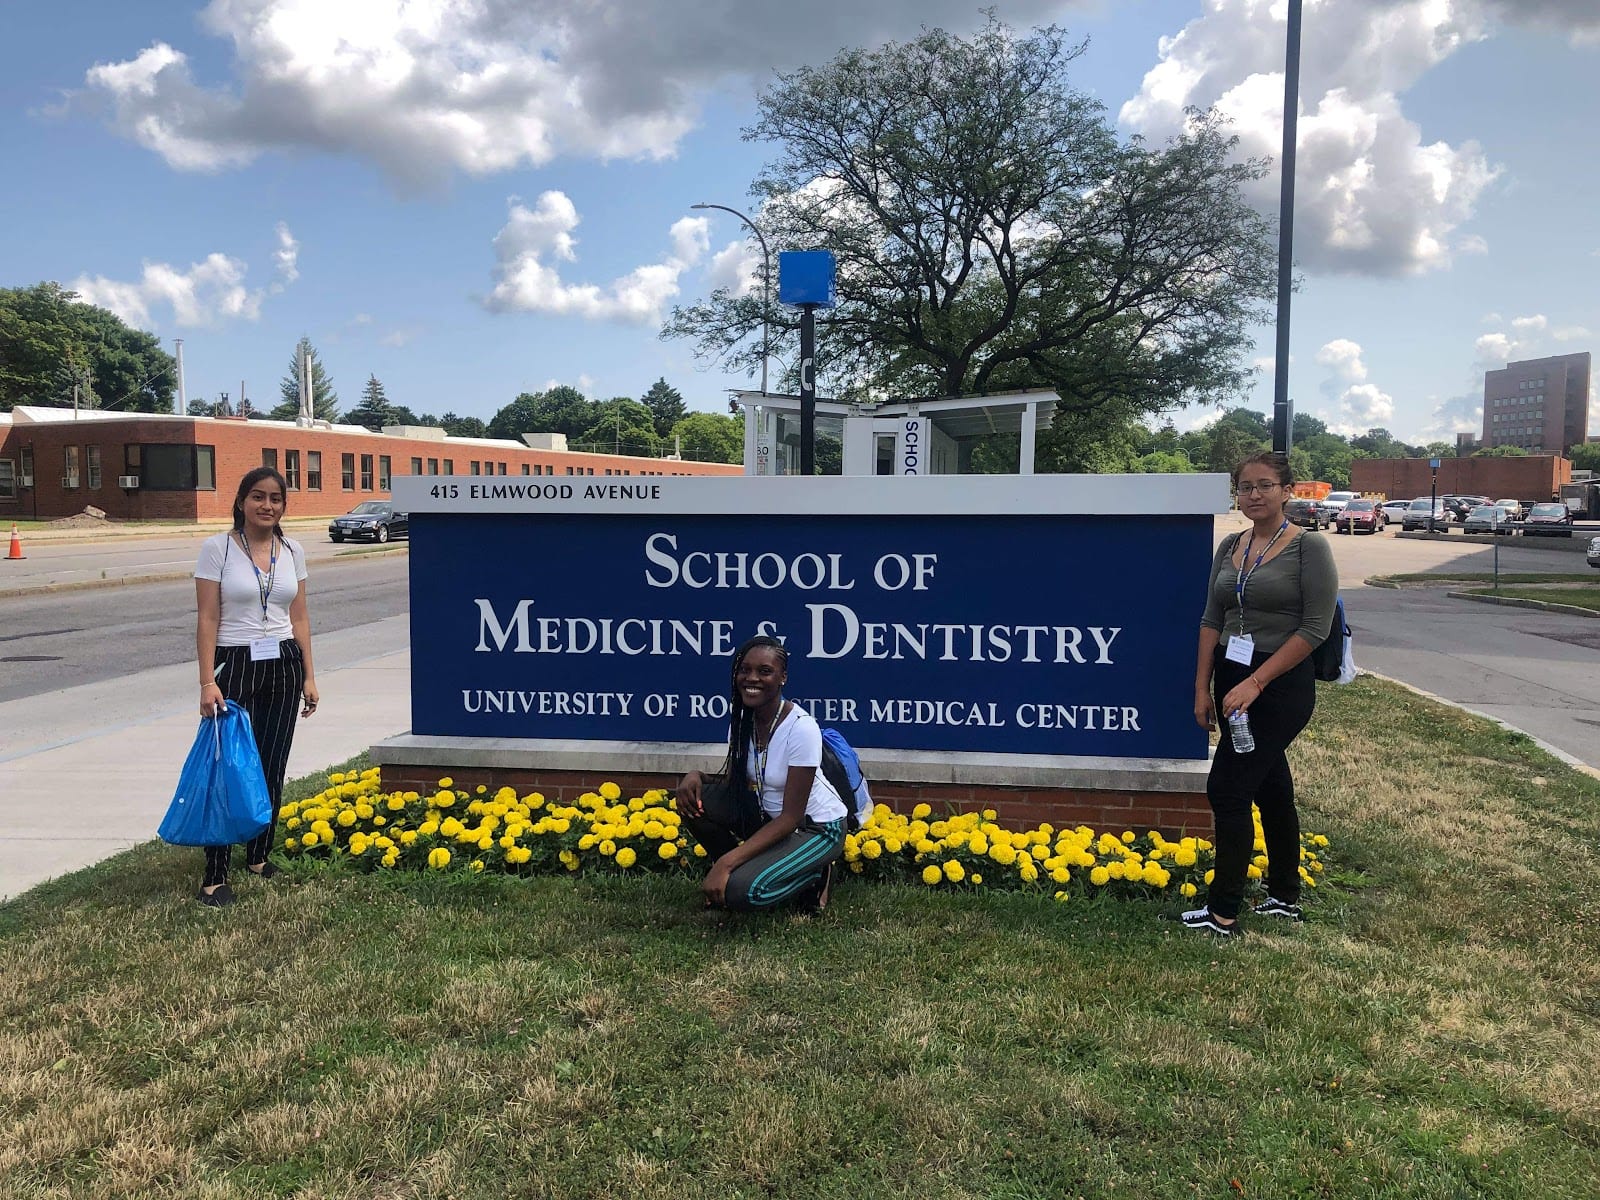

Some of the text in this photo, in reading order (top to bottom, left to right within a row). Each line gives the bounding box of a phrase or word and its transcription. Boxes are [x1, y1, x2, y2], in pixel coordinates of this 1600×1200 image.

[430, 484, 661, 500] 415 ELMWOOD AVENUE
[645, 532, 938, 591] SCHOOL OF
[473, 598, 736, 657] MEDICINE
[804, 603, 1122, 665] DENTISTRY
[462, 689, 1142, 732] UNIVERSITY OF ROTER MEDICAL CENTER
